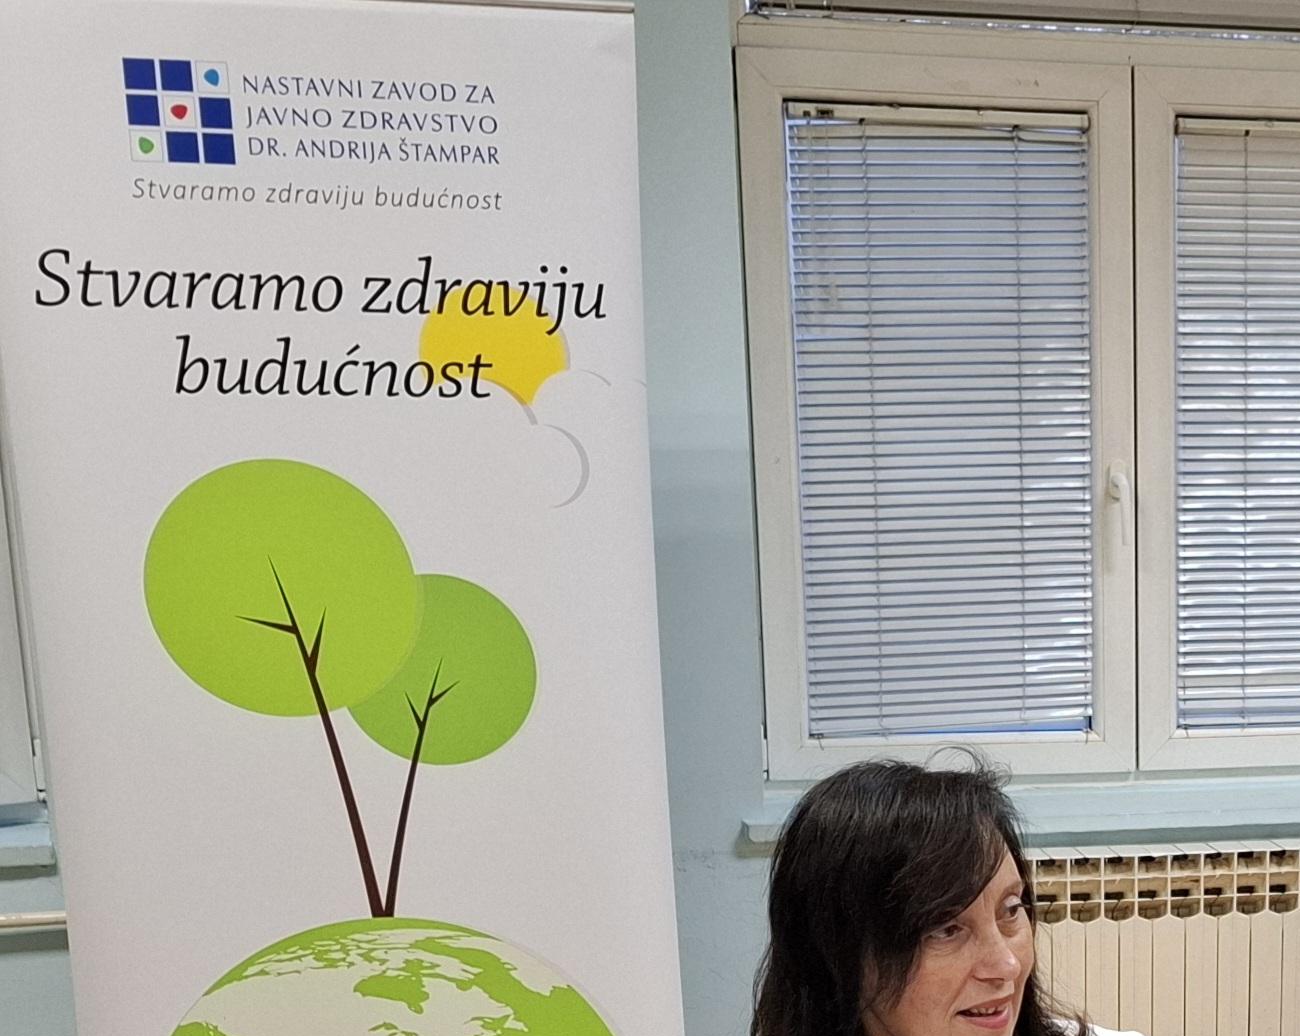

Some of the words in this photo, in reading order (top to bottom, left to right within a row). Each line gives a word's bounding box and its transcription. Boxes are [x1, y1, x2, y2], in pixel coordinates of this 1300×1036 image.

[242, 74, 363, 99] NASTAVNI
[371, 80, 457, 103] ZAVOD
[465, 84, 496, 105] ZA
[245, 106, 333, 129] JAVNO
[342, 109, 498, 135] ZDRAVSTVO
[248, 136, 287, 158] DR.
[295, 138, 392, 163] ANDRIJA
[398, 137, 500, 165] ŠTAMPAR
[133, 177, 256, 203] Stvaramo
[265, 182, 364, 211] zdraviju
[374, 185, 503, 211] budućnost
[34, 249, 344, 313] Stvaramo
[361, 256, 607, 335] zdraviju
[175, 336, 493, 398] budućnost
